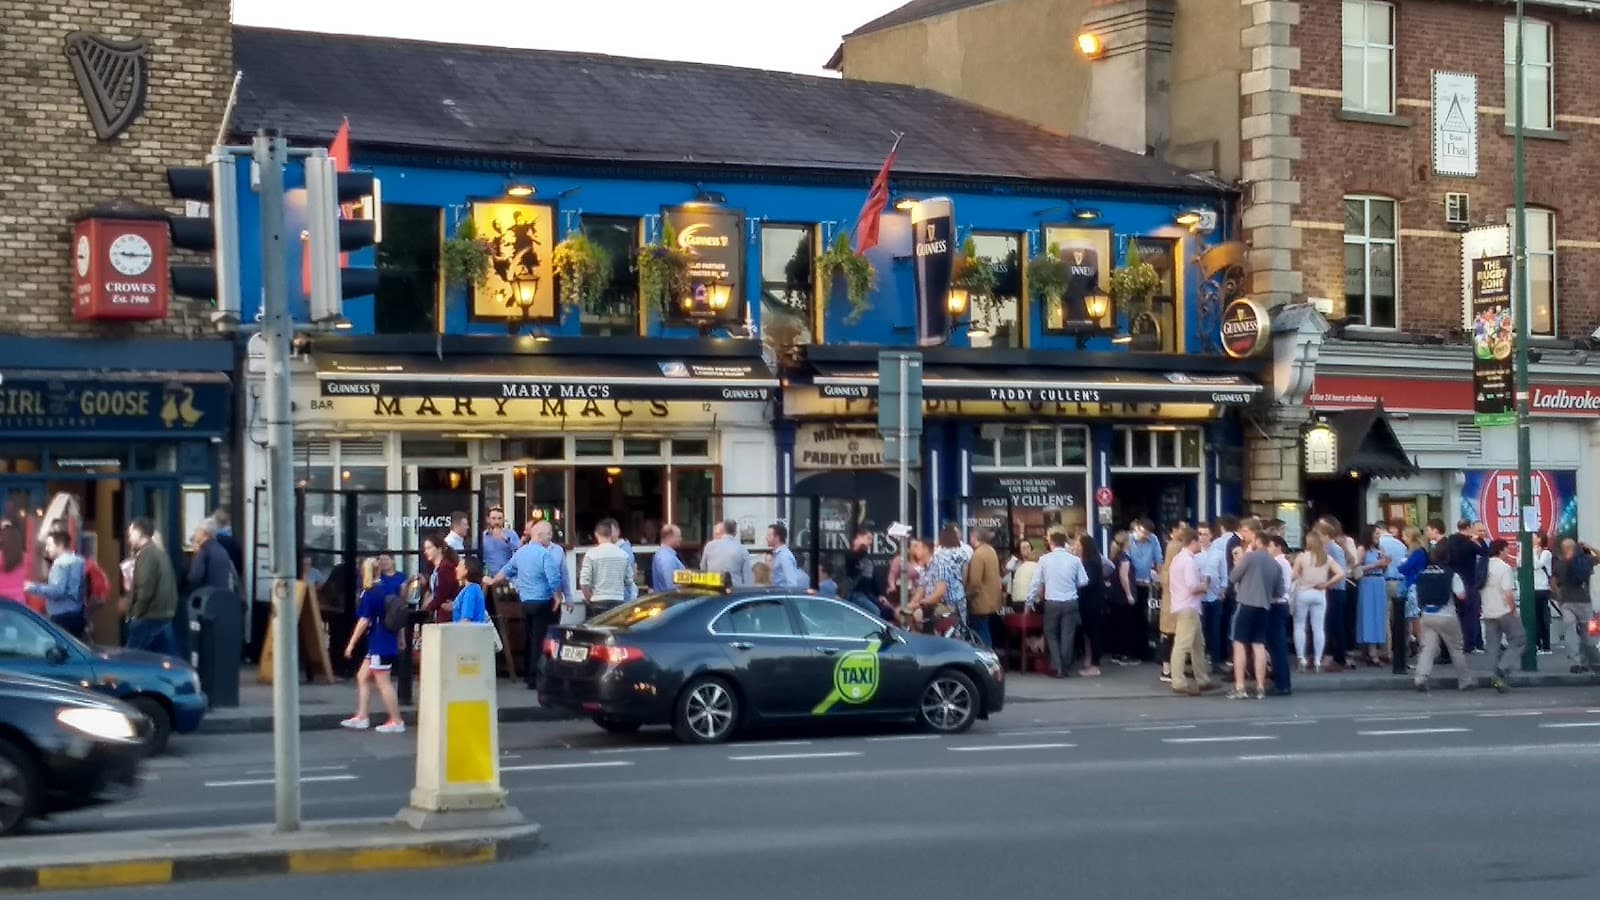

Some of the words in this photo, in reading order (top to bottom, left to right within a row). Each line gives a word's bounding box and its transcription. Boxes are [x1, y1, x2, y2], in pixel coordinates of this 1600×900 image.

[917, 241, 947, 257] GUINNESS
[1483, 260, 1501, 271] THE
[1477, 268, 1507, 281] RUGBY
[105, 282, 156, 294] CROWES
[1480, 278, 1504, 290] ZONE
[1223, 320, 1258, 336] GUINNESS
[327, 383, 370, 394] GUINNESS
[502, 384, 553, 397] MARY
[560, 385, 610, 399] MAC'S
[722, 388, 759, 400] GUINNESS
[824, 385, 860, 397] GUINNESS
[990, 388, 1033, 401] PADDY
[1040, 389, 1100, 402] CULLEN'S
[1211, 392, 1244, 402] GUINNESS
[80, 390, 149, 415] GOOSE
[310, 400, 334, 411] BAR
[702, 402, 712, 412] 12
[803, 450, 847, 465] PADDY
[850, 453, 884, 465] CULL
[1021, 495, 1074, 507] CULLEN'S
[1496, 475, 1513, 517] 5
[419, 516, 451, 527] MAC'S
[841, 666, 873, 685] TAXI
